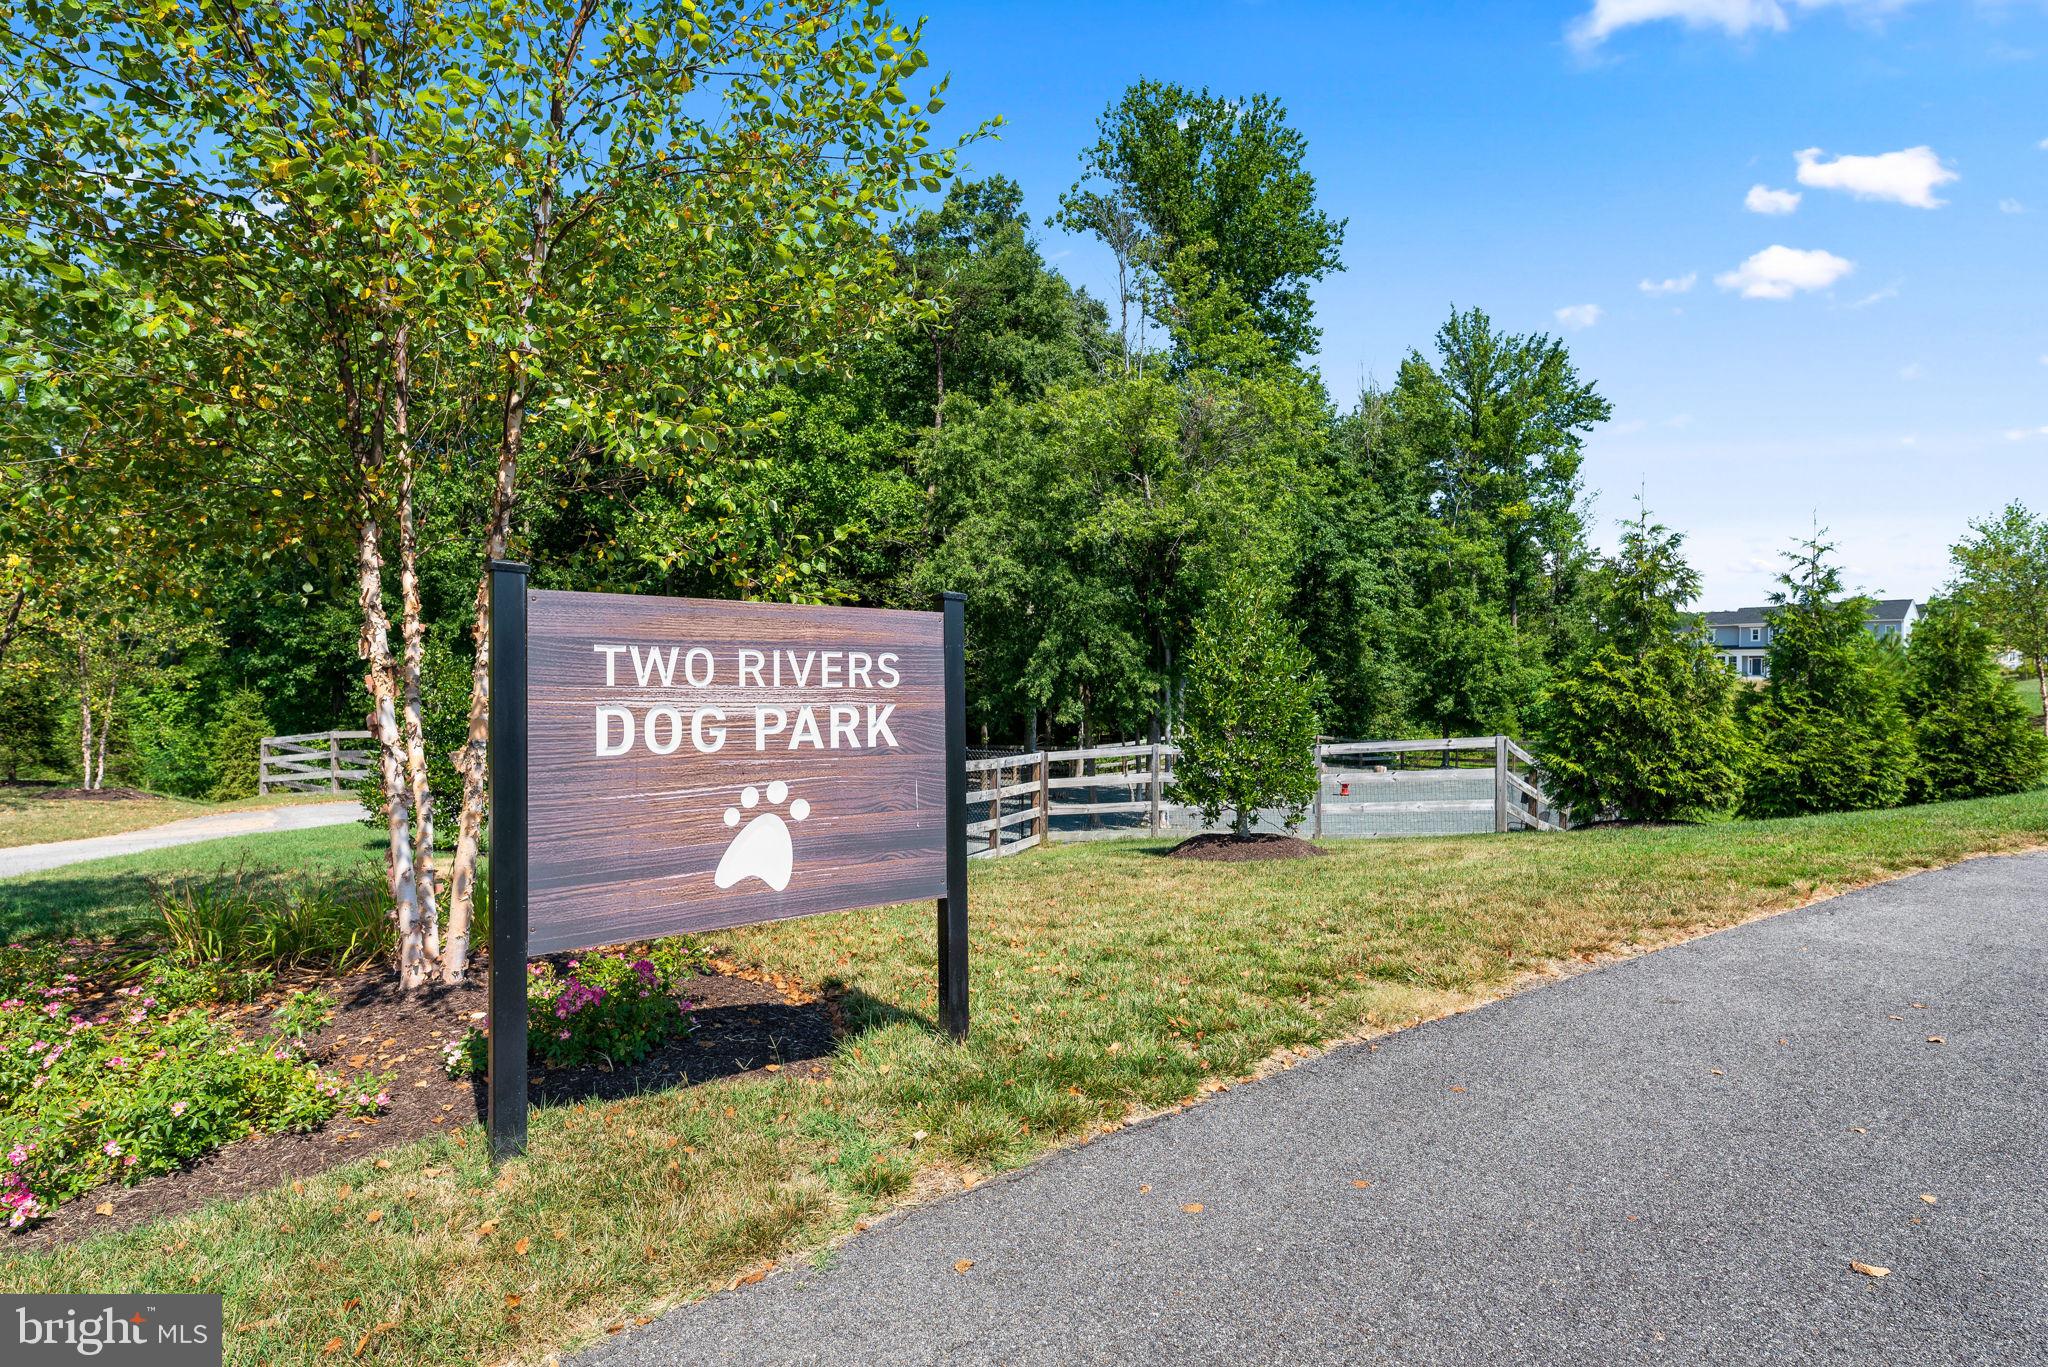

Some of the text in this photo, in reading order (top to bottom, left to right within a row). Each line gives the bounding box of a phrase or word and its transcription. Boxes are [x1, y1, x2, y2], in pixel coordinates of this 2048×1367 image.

[593, 644, 901, 689] TWO RIVERS
[595, 703, 900, 757] DOG PARK
